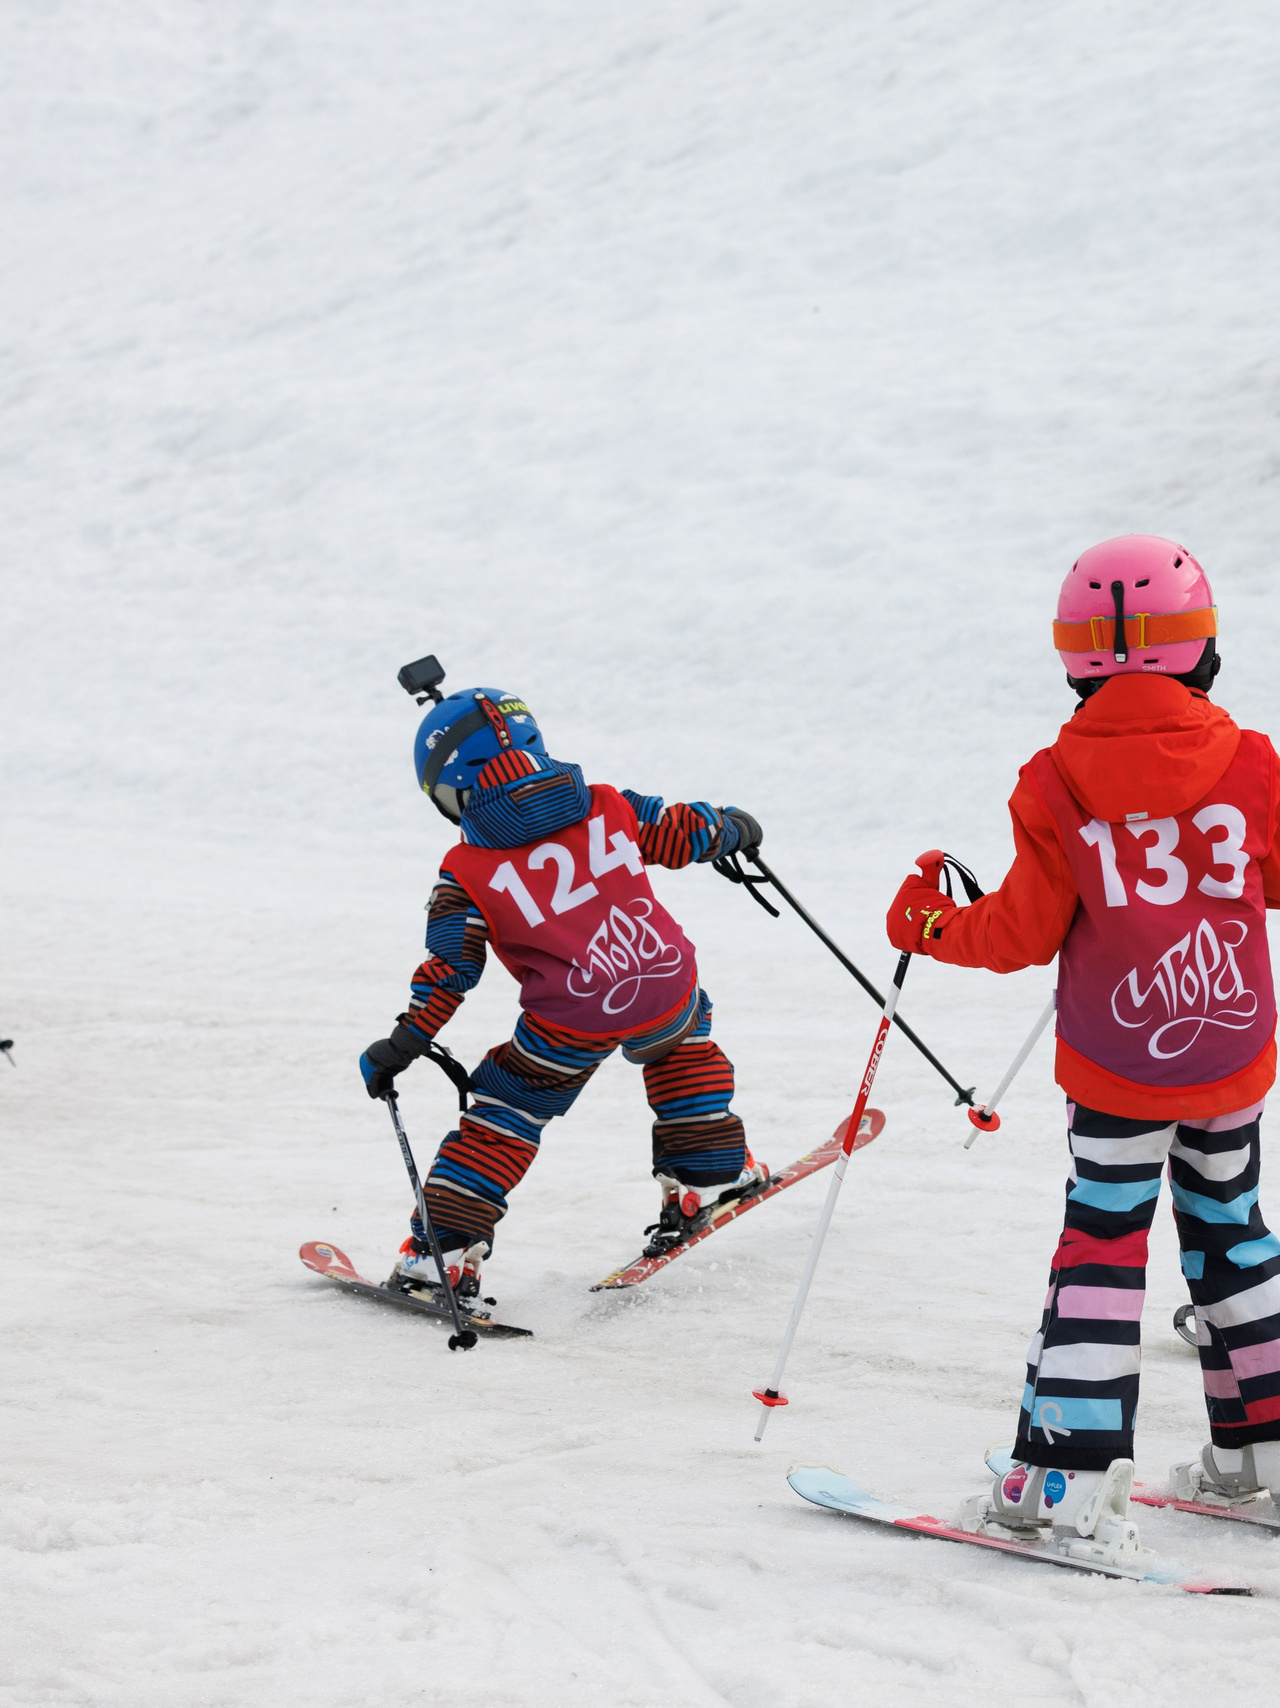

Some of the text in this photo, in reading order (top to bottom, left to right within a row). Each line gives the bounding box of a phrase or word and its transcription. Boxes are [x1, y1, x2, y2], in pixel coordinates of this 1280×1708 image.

[497, 701, 532, 714] uve
[488, 813, 646, 929] 124
[1078, 803, 1251, 908] 133
[861, 1028, 889, 1097] COBER
